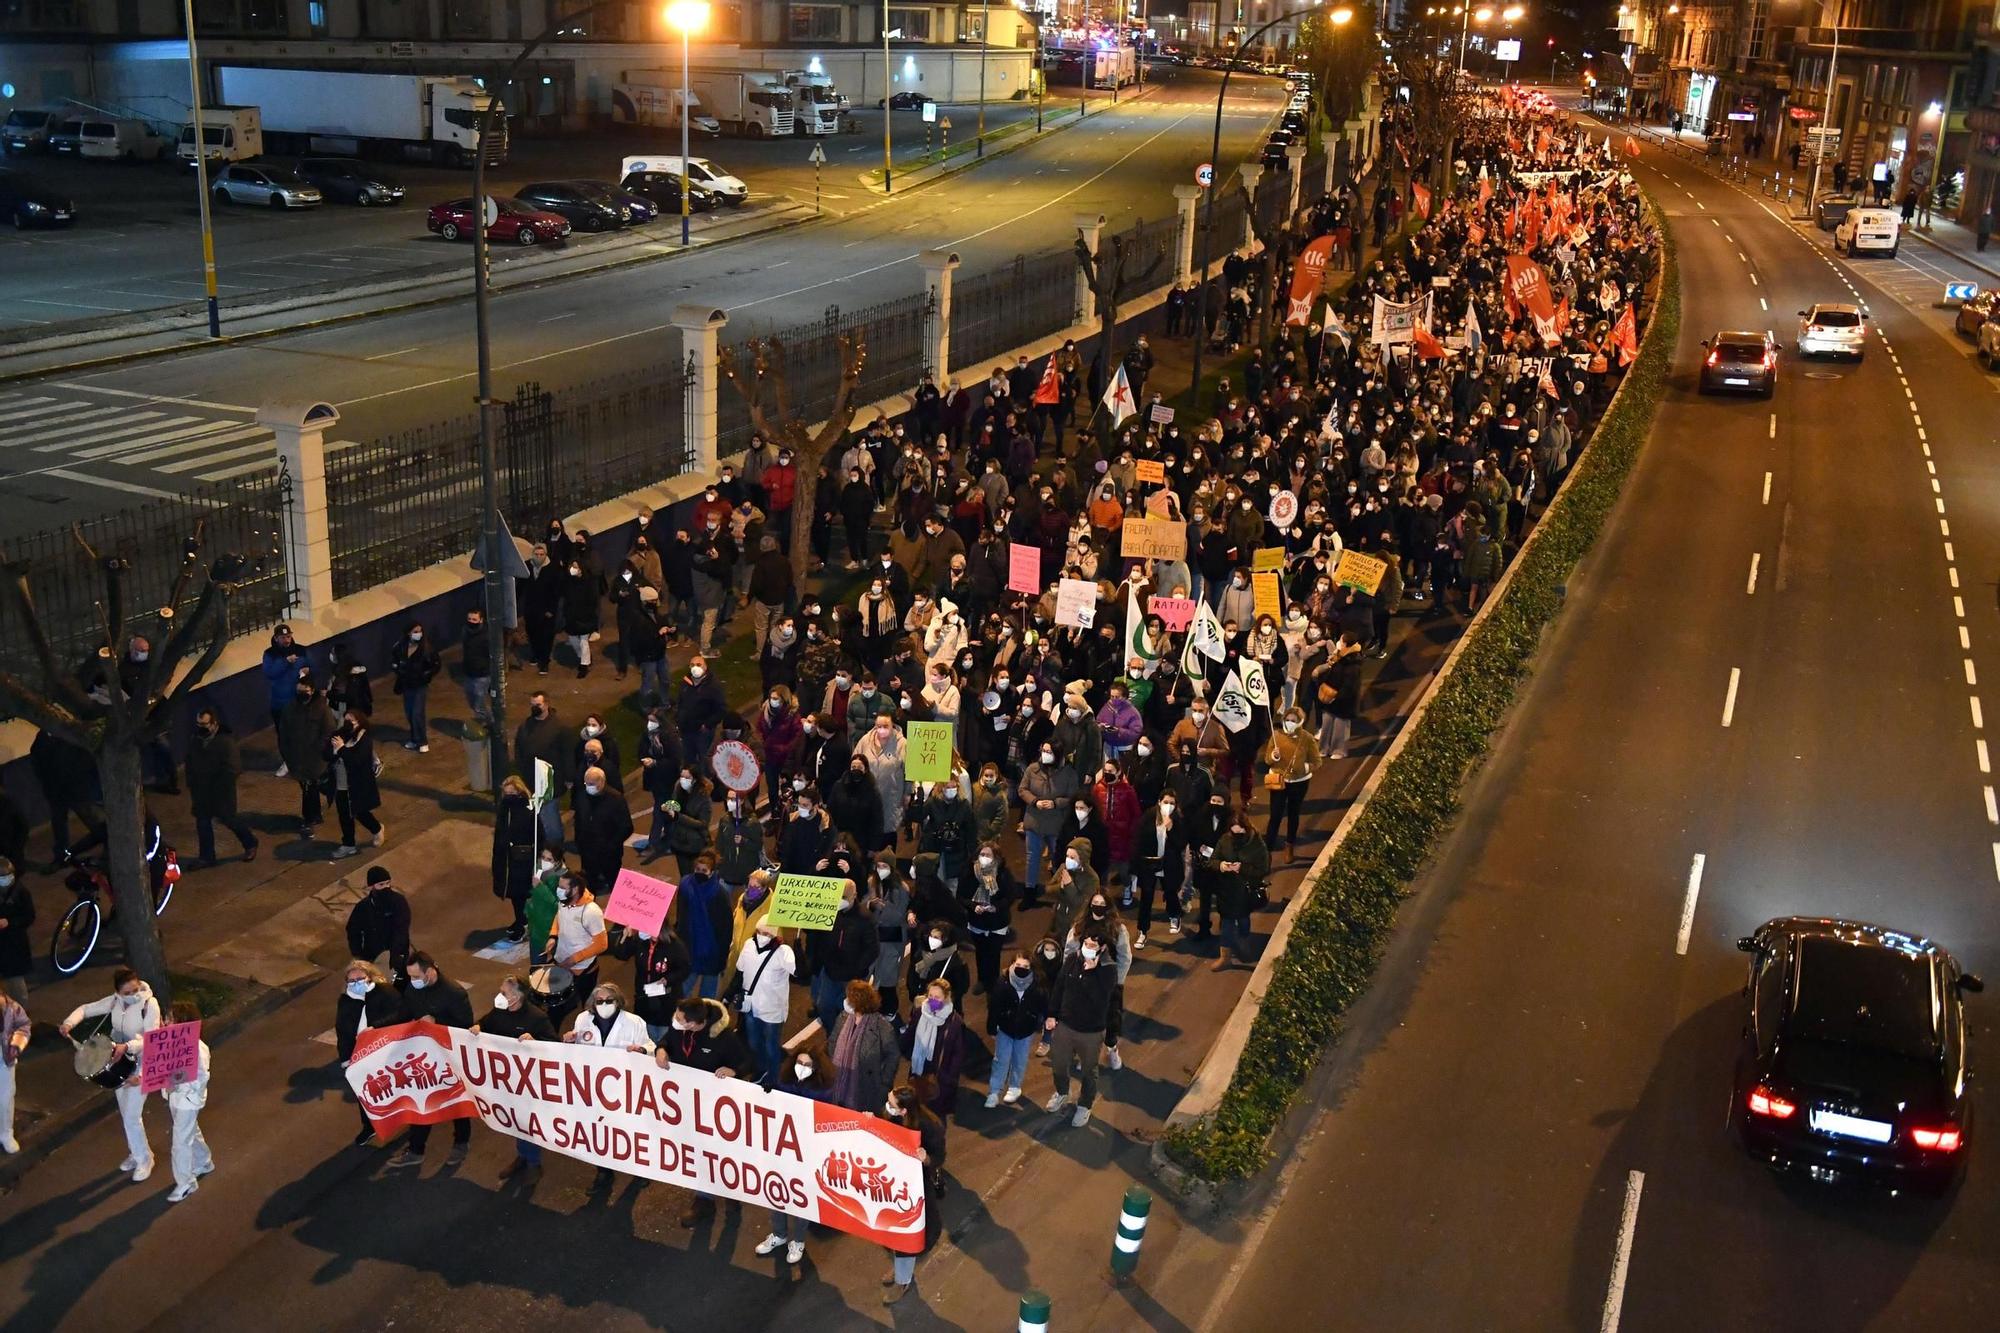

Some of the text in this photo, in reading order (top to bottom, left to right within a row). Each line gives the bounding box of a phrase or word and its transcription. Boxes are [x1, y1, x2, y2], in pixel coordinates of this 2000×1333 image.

[1199, 171, 1213, 180] 40
[1153, 600, 1190, 611] RATIO
[913, 727, 948, 741] RATIO
[923, 741, 937, 752] 12
[919, 752, 937, 766] YA
[780, 877, 839, 891] URXENCIAS
[149, 1026, 191, 1044] POLA
[146, 1057, 194, 1077] ACUDE
[459, 1044, 804, 1163] URXENCIAS LOITA
[815, 1120, 861, 1133] COIDARTE
[474, 1096, 810, 1211] POLA SAÚDE DE TOD@S
